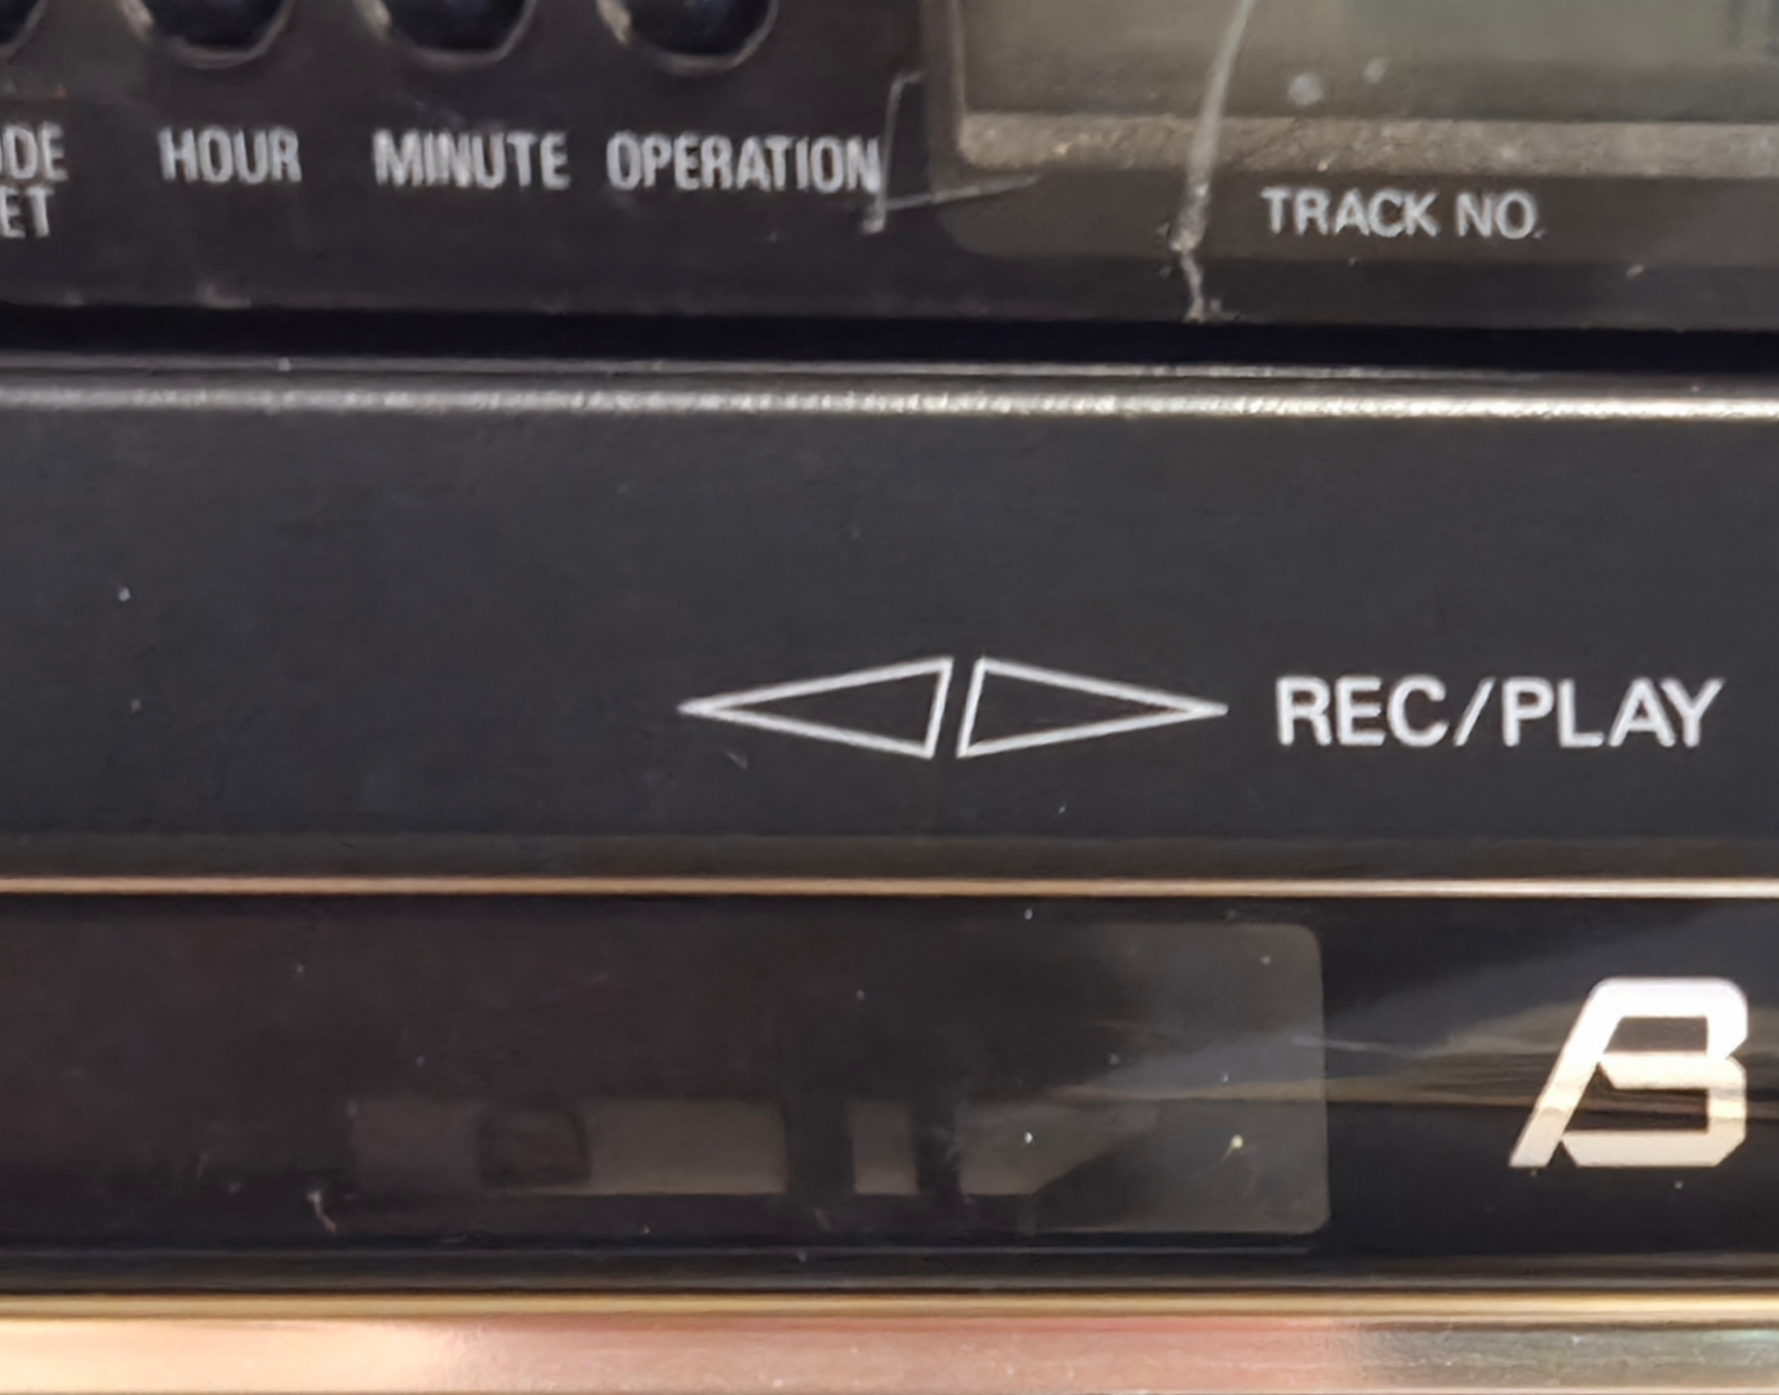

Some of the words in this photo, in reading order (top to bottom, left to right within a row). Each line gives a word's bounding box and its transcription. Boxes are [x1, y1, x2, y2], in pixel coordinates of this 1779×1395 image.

[159, 127, 301, 184] HOUR
[373, 130, 567, 189] MINUTE
[607, 132, 881, 191] OPERATION
[1261, 186, 1438, 238] TRACK
[1276, 676, 1722, 748] REC/PLAY
